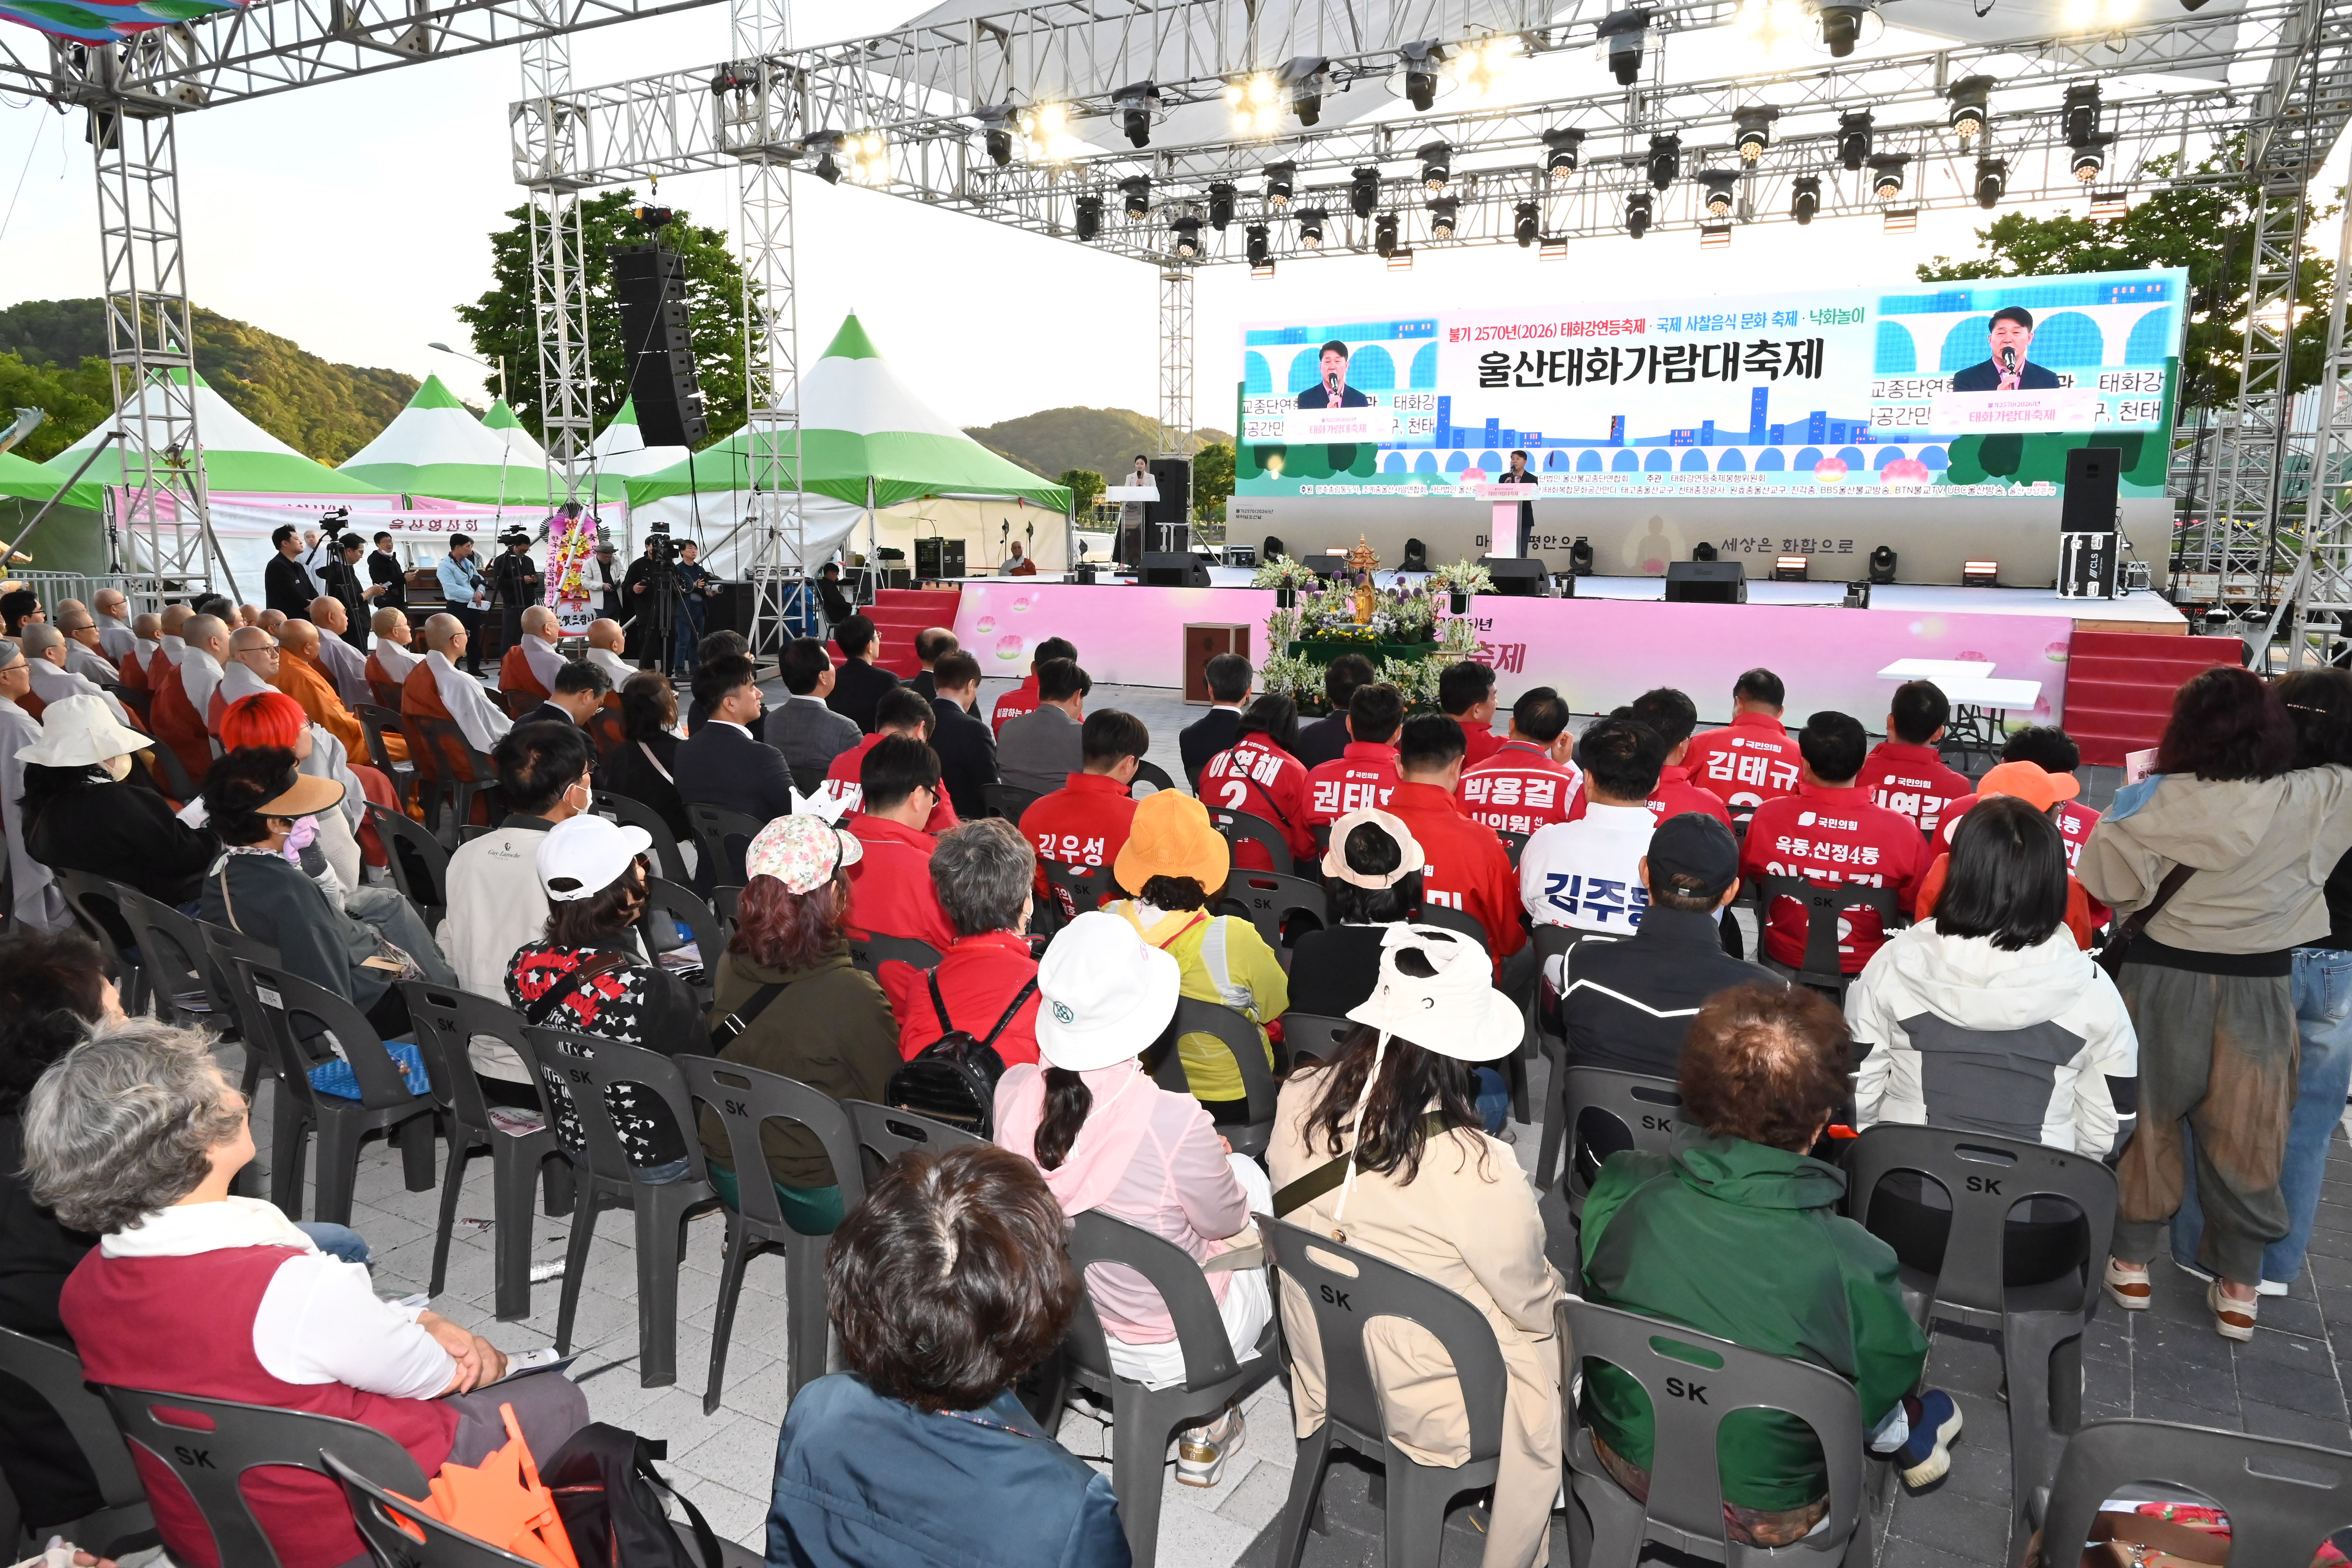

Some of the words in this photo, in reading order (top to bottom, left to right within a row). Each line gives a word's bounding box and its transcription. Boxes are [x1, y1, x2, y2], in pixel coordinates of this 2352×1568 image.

[1449, 327, 1471, 342] 불기
[1474, 322, 1556, 340] 2570년(2026)
[1561, 318, 1646, 337] 태화강연등축제
[1657, 316, 1681, 333] 국제
[1685, 313, 1736, 332] 사찰음식
[1741, 312, 1767, 329] 문화
[1771, 310, 1797, 327] 축제
[1810, 307, 1865, 326] 낙화놀이
[1478, 338, 1824, 388] 울산태화가람대축제
[2100, 372, 2164, 394] 태화강
[1394, 394, 1435, 411] 태화강
[1969, 409, 2056, 423] 태화가람대축제
[1309, 424, 1367, 435] 태화가람대축제
[1563, 474, 1628, 483] 울산불교종단연합회
[1646, 474, 1662, 483] 주관
[1671, 474, 1766, 483] 태화강연등축제봉행위원회
[1301, 485, 1313, 494] 후원
[1430, 485, 1456, 494] 사단법인
[1721, 536, 1773, 554] 세상은
[1782, 538, 1854, 554] 화합으로
[1247, 741, 1269, 752] 국민의힘
[1746, 740, 1782, 753] 국민의힘
[1209, 750, 1284, 787] 이영해
[1356, 771, 1379, 780] 국민의힘
[1706, 751, 1799, 791] 김태규
[1897, 777, 1931, 789] 국민의힘
[1464, 777, 1556, 808] 박용걸
[706, 827, 720, 838] SK
[1818, 817, 1858, 831] 국민의힘
[1039, 834, 1105, 866] 김우성
[1775, 835, 1880, 865] 옥동,신정4동
[1074, 885, 1091, 896] SK
[1254, 898, 1272, 910] SK
[1814, 897, 1833, 908] SK
[851, 949, 869, 963] SK
[437, 1017, 458, 1034] SK
[569, 1069, 594, 1085] SK
[725, 1098, 750, 1118] SK
[1642, 1115, 1672, 1133] SK
[1965, 1175, 2003, 1196] SK
[1320, 1283, 1353, 1312] SK
[1665, 1377, 1709, 1406] SK
[174, 1445, 216, 1470] SK
